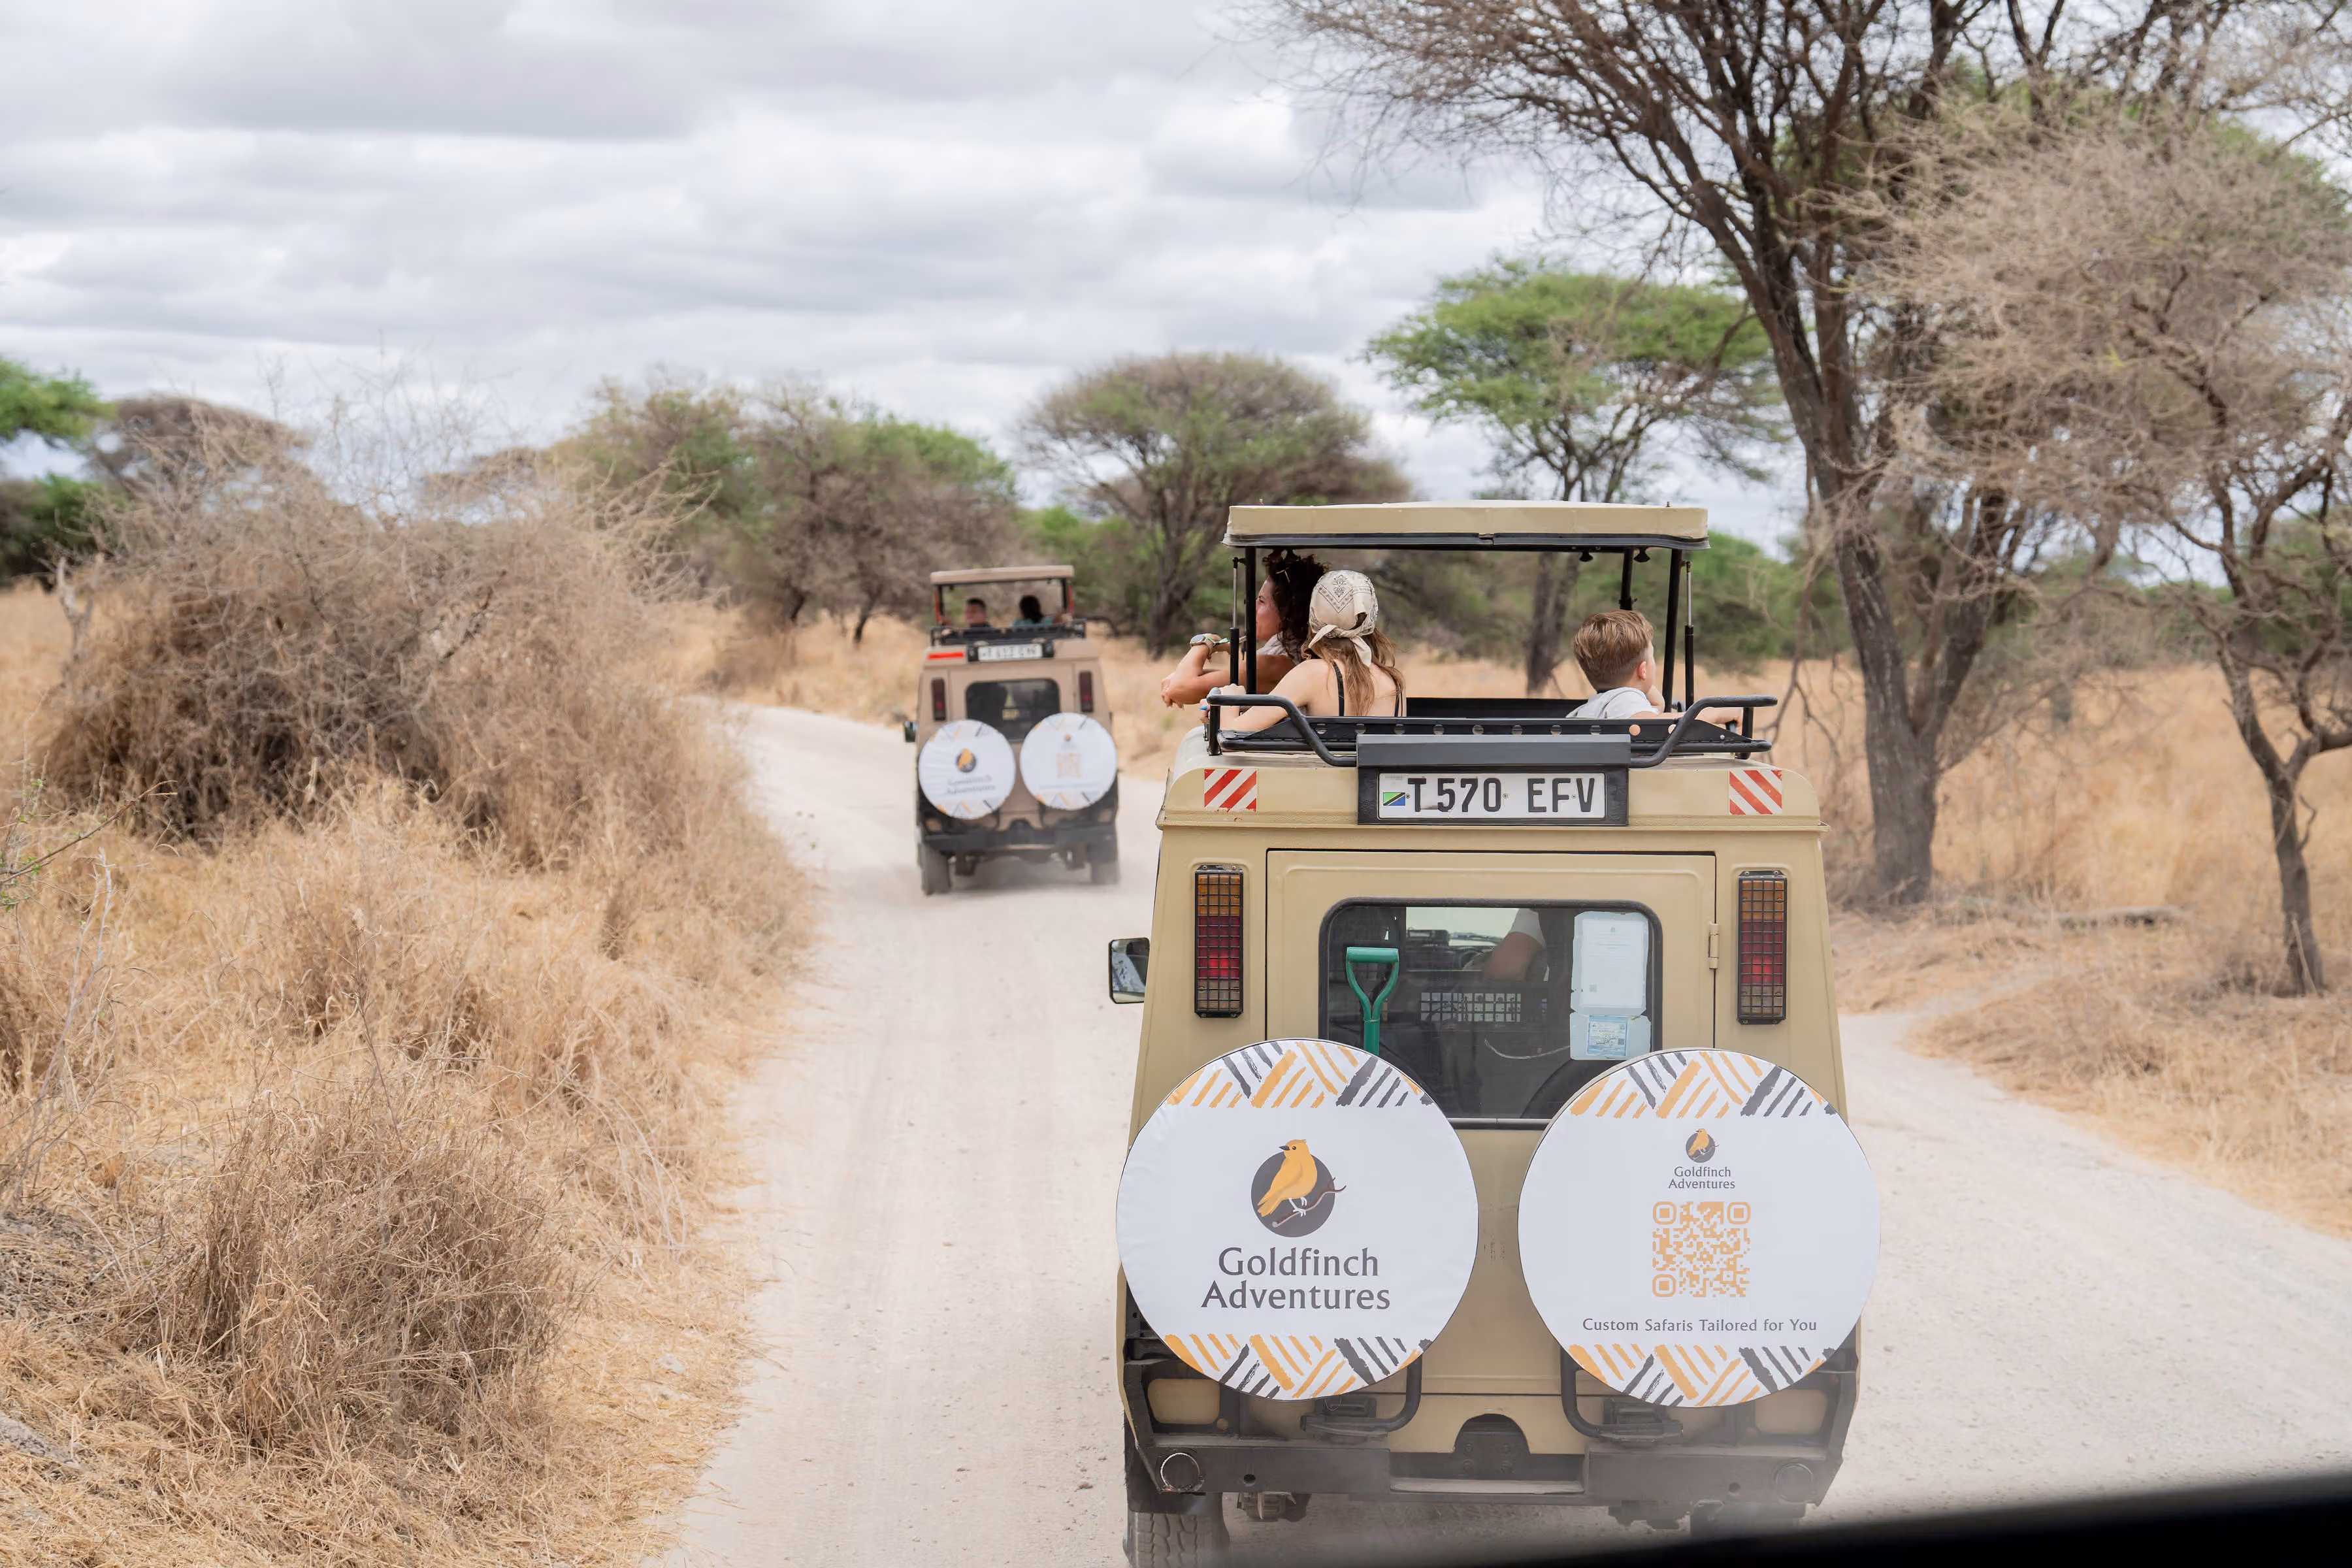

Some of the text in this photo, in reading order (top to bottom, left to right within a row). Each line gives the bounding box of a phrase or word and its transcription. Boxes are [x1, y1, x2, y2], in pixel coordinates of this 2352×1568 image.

[1527, 777, 1595, 813] EFV
[1674, 1166, 1731, 1177] Goldfinch
[1668, 1177, 1735, 1189] Adventures
[1218, 1247, 1379, 1277] Goldfinch
[1200, 1279, 1390, 1310] Adventures
[1582, 1318, 1817, 1331] Custom Safaris Tailored for You
